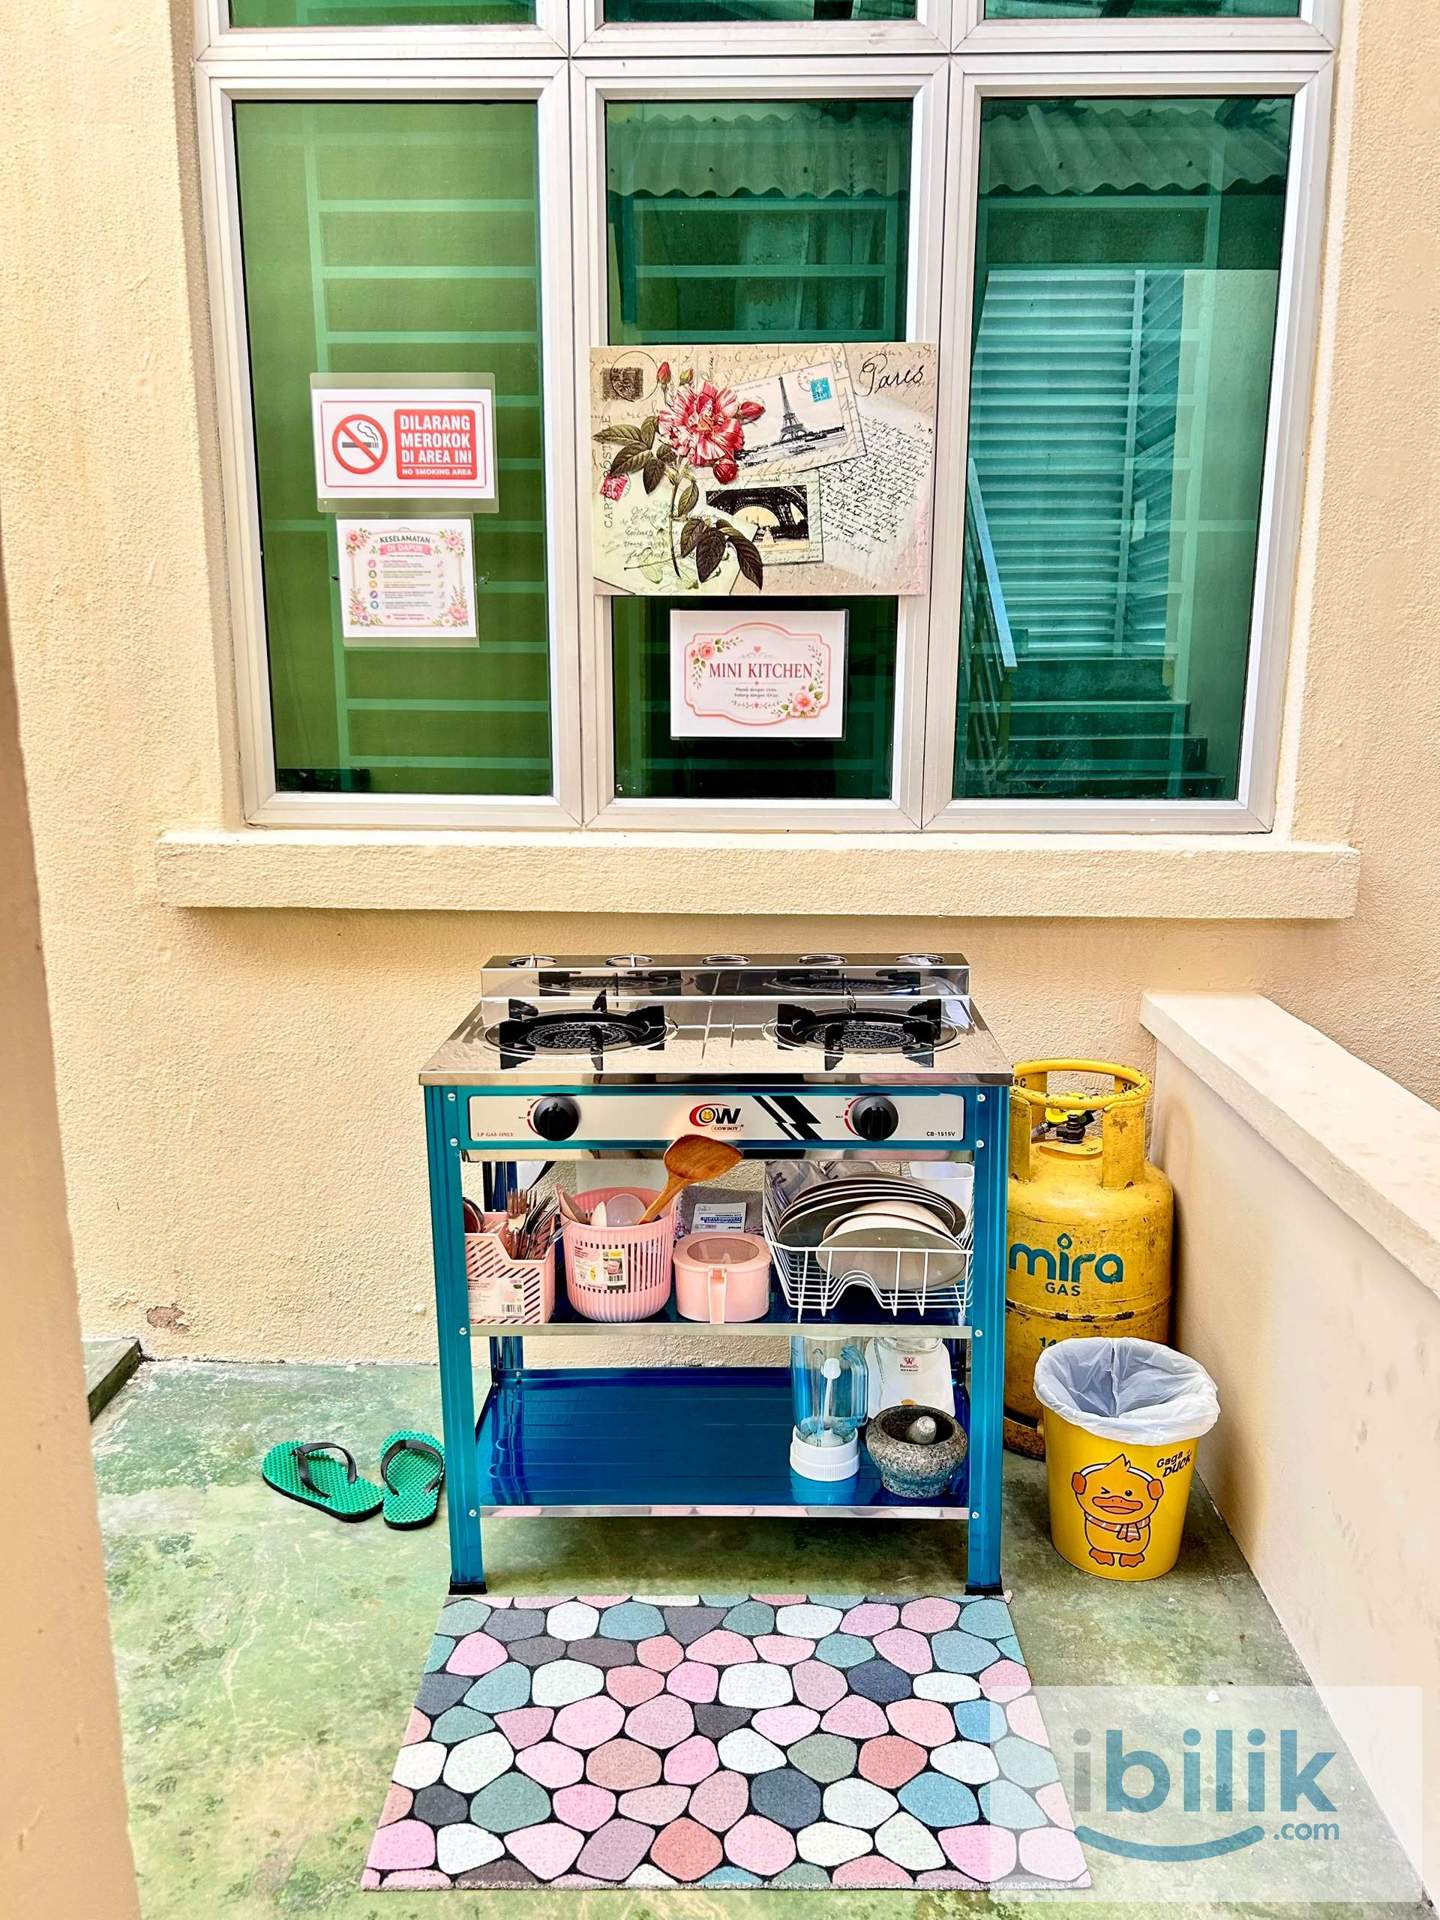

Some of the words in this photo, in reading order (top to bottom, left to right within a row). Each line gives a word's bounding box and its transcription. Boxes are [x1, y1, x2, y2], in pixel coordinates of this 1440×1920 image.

[854, 353, 924, 397] Paris
[400, 415, 471, 430] DILARANG
[401, 433, 471, 448] MEROKOK
[402, 451, 414, 464] DI
[418, 451, 450, 464] AREA
[455, 451, 472, 463] INI
[402, 468, 413, 476] NO
[415, 468, 450, 476] SMOKING
[452, 468, 472, 476] AREA
[380, 535, 431, 543] KESELAMATAN
[709, 663, 742, 678] MINI
[748, 663, 813, 679] KITCHEN
[1008, 1232, 1124, 1285] mira
[1045, 1282, 1081, 1297] GAS
[1157, 1451, 1184, 1468] Gaga
[1163, 1454, 1191, 1478] DUCK
